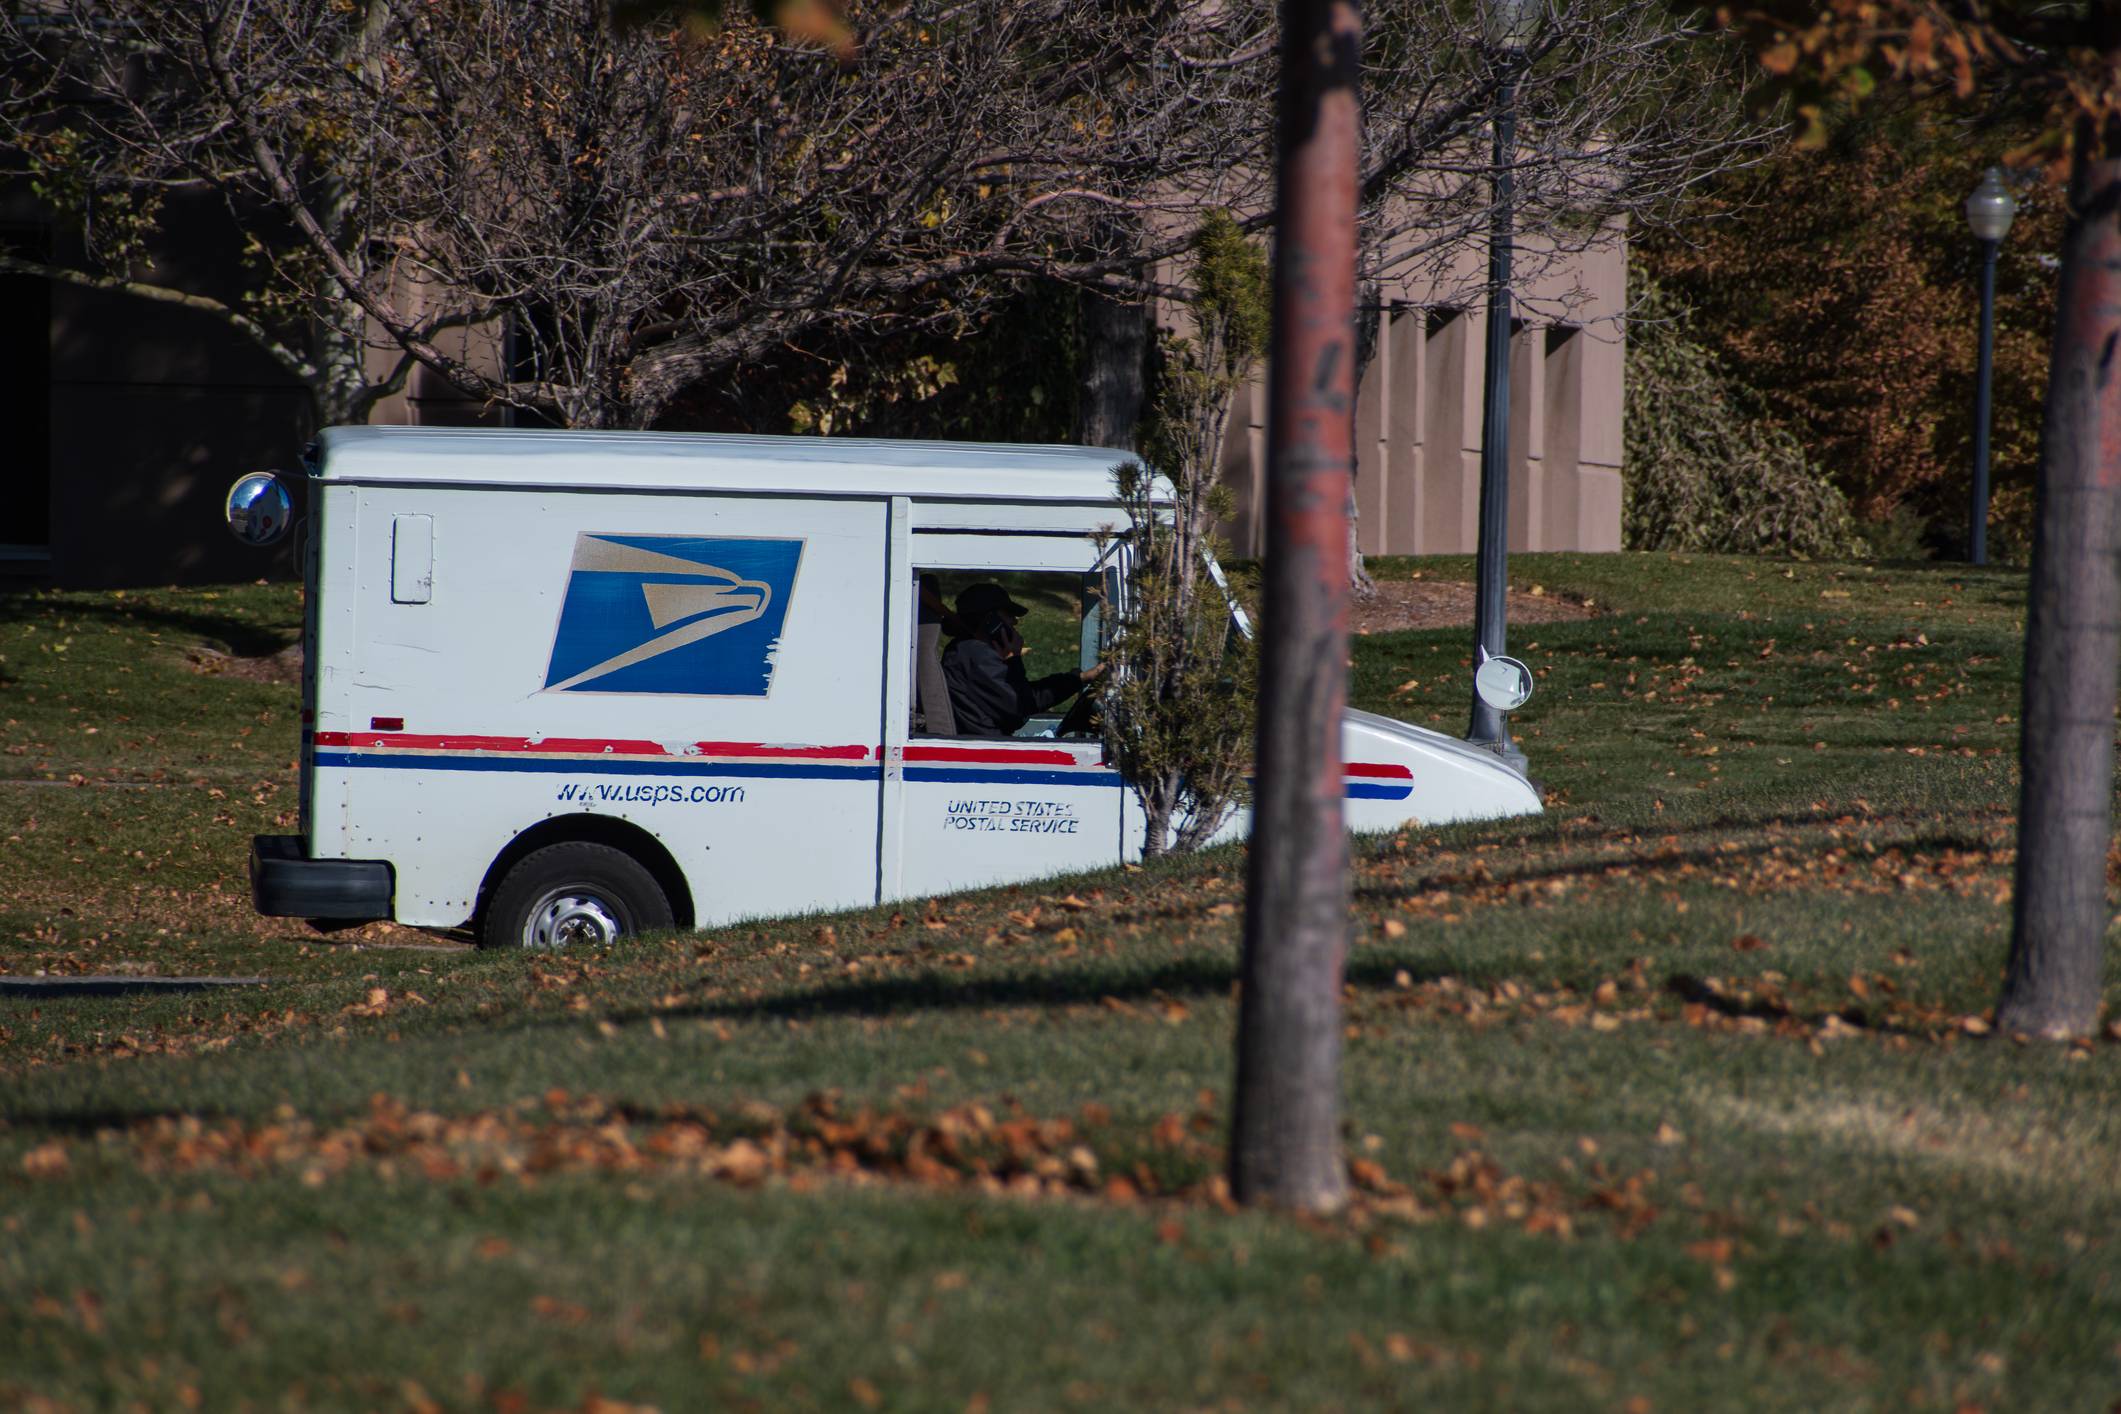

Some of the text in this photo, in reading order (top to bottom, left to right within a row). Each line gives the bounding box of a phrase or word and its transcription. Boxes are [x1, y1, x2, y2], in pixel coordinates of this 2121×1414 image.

[948, 800, 1073, 816] UNITED STATES
[944, 816, 1079, 834] POSTAL SERVICE
